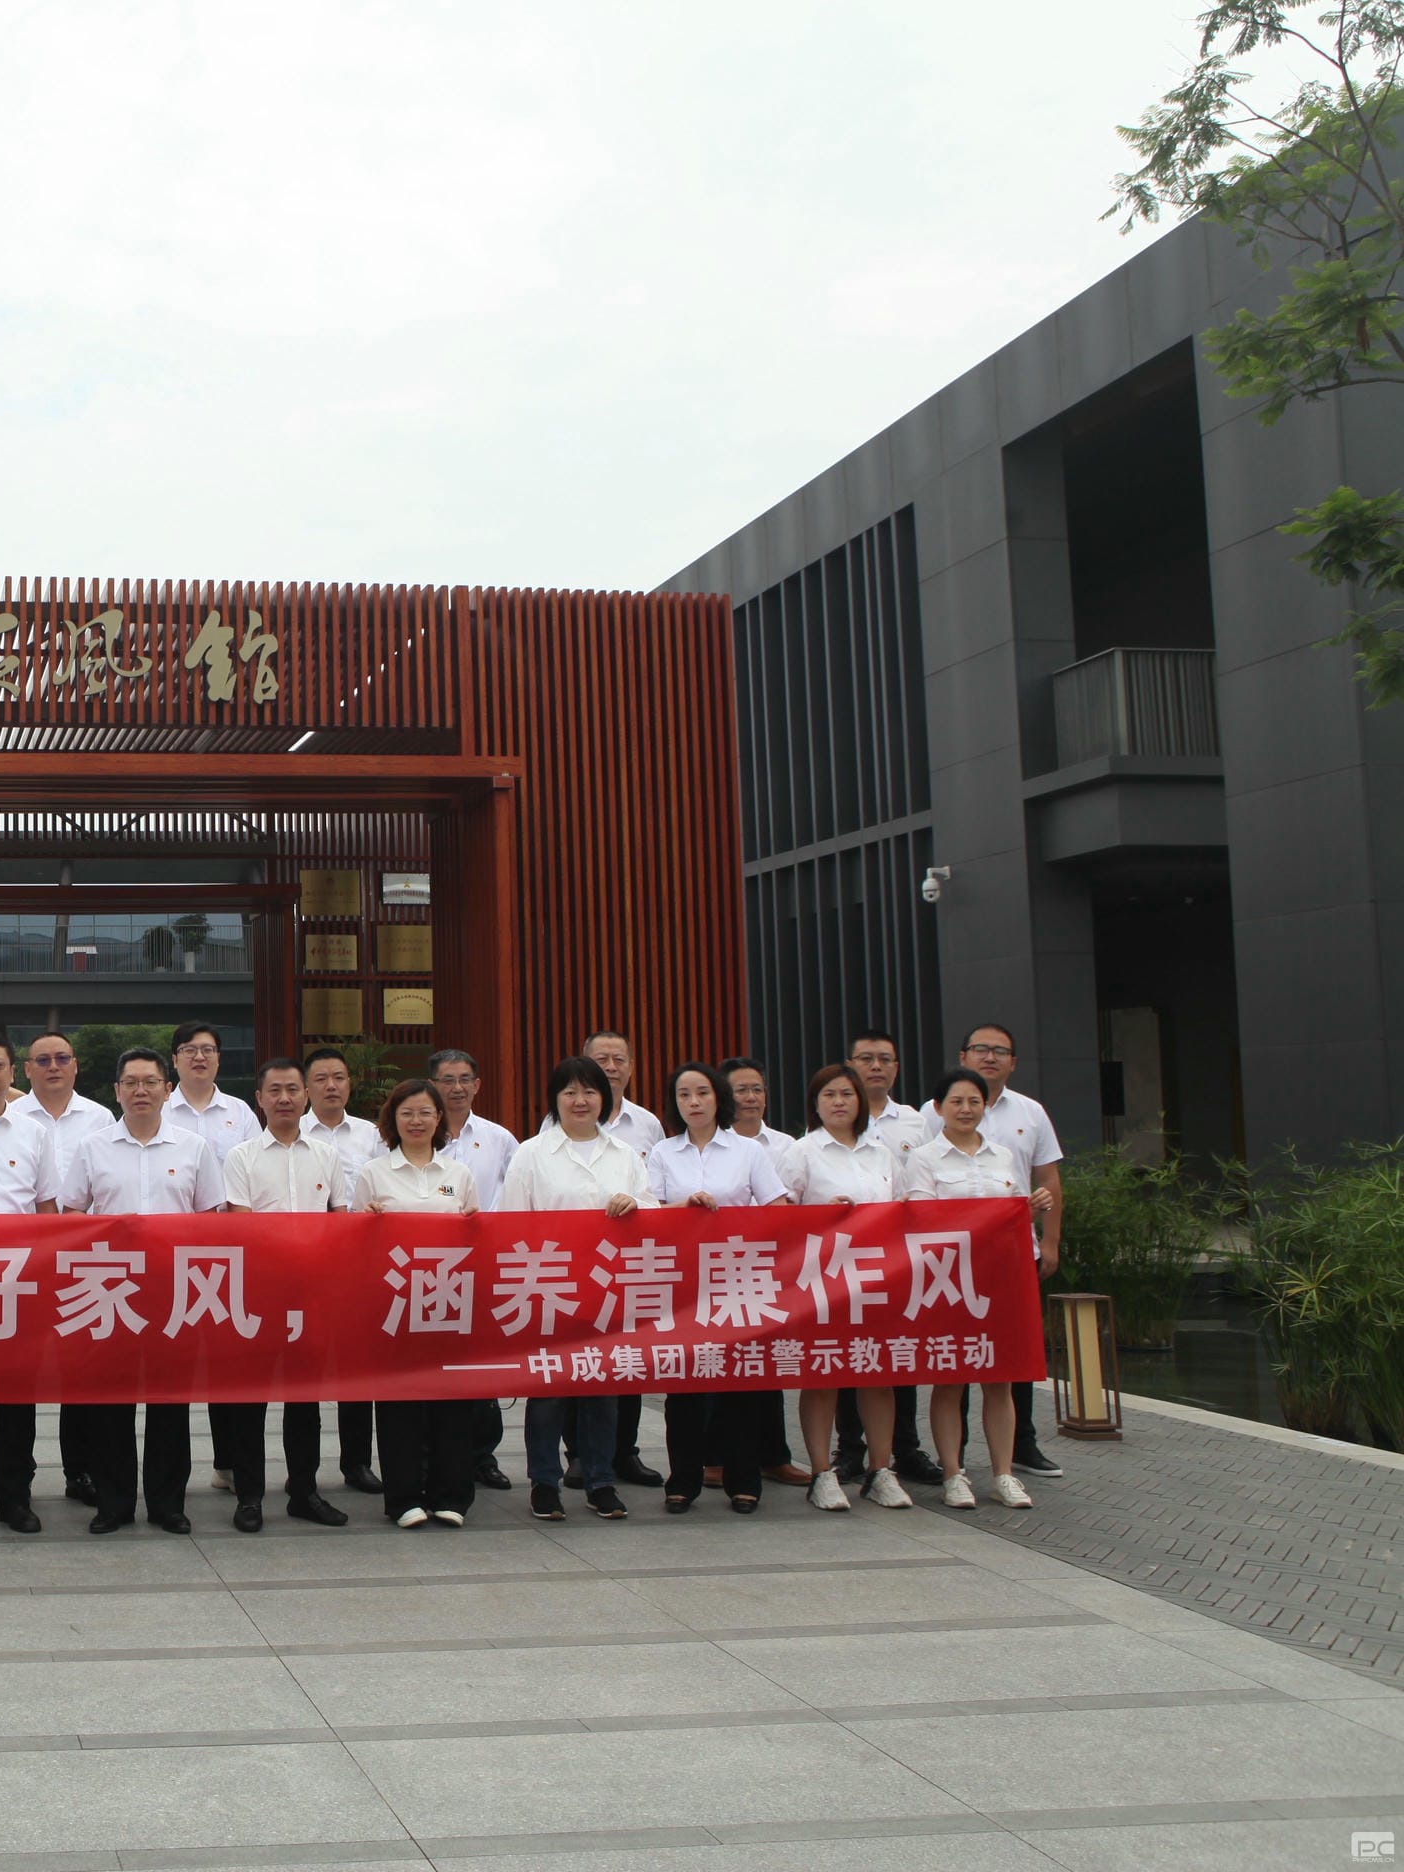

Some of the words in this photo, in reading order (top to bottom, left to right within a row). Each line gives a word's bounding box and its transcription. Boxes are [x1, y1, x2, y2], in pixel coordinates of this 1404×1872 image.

[382, 1230, 991, 1337] 涵养清廉作风
